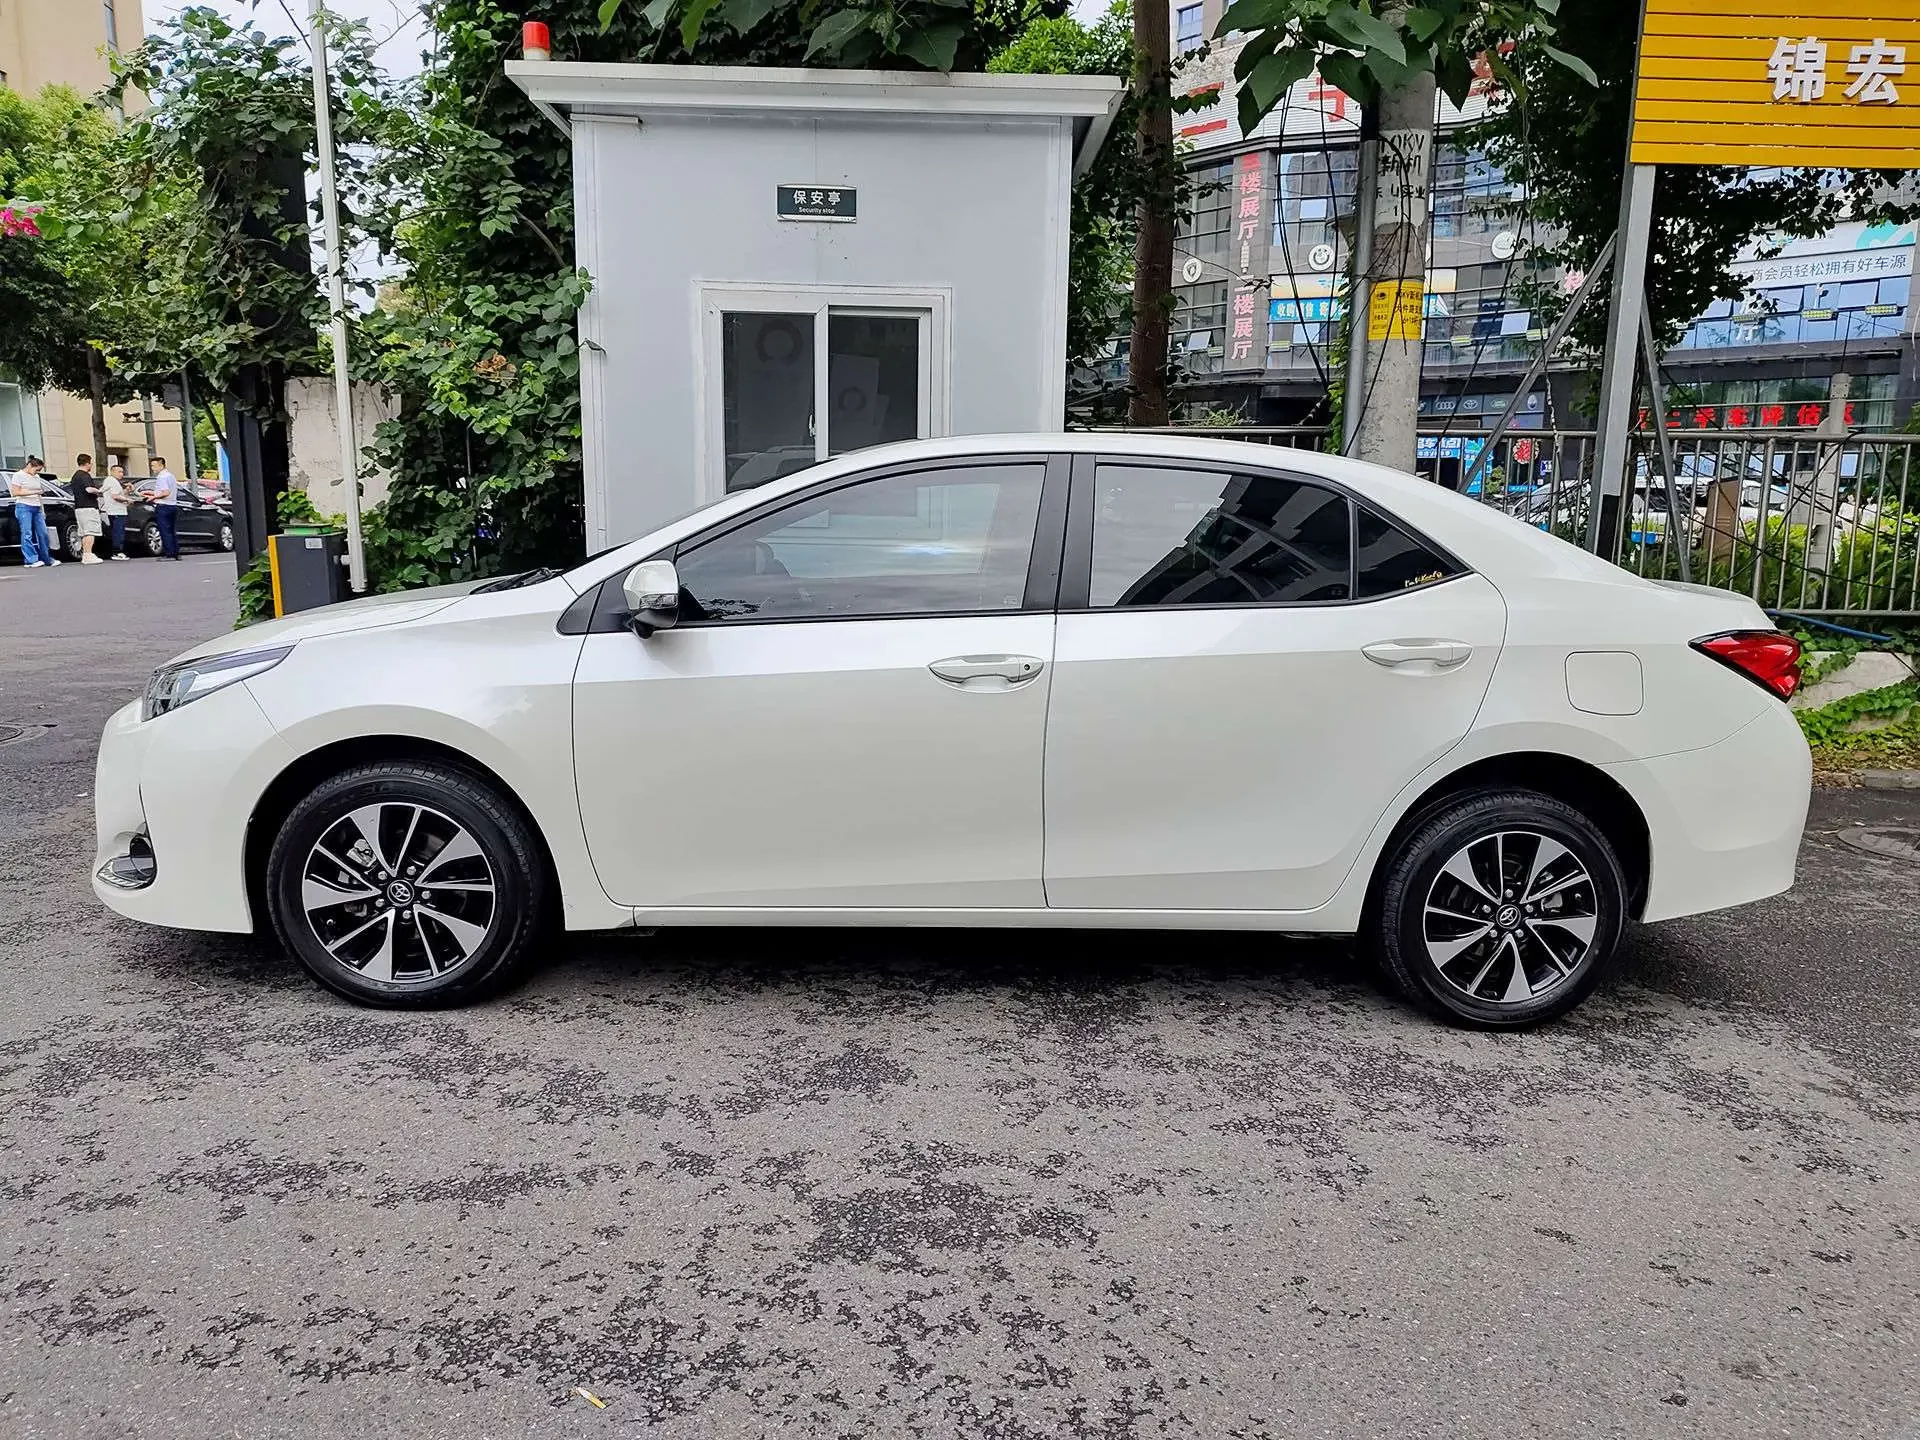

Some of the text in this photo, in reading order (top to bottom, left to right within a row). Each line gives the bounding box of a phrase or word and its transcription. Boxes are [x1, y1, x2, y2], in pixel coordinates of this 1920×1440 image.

[1766, 36, 1906, 104] 锦宏
[793, 190, 841, 206] 保安亭
[798, 206, 822, 214] Security
[1231, 275, 1255, 361] 二楼展厅
